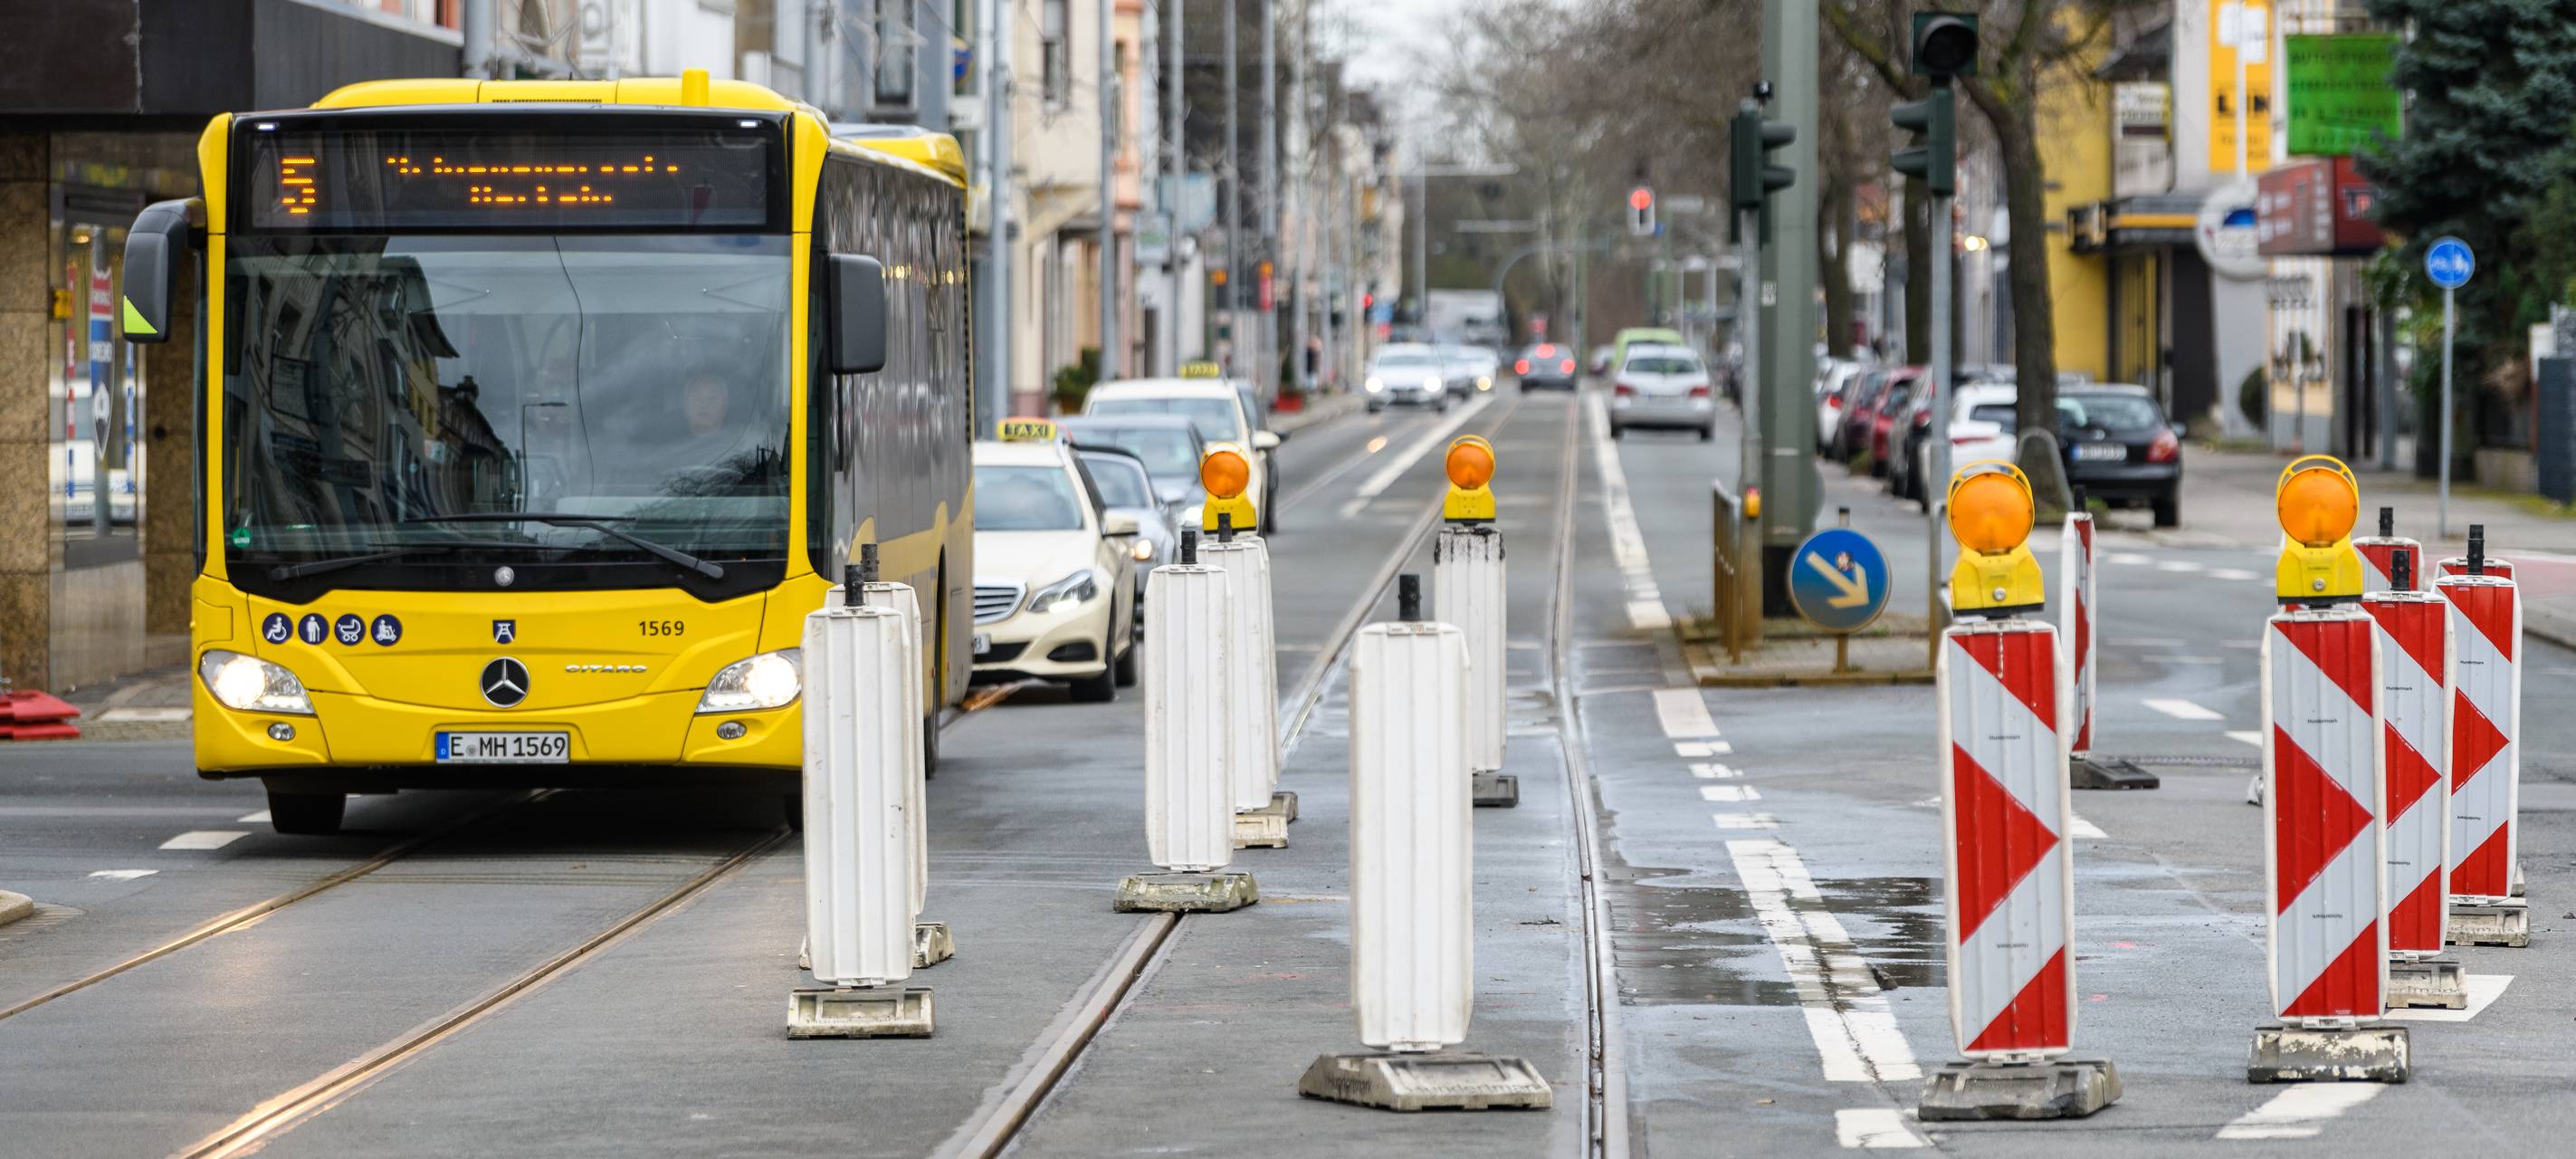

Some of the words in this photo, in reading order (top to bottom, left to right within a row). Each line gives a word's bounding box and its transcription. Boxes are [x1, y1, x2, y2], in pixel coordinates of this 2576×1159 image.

[282, 158, 316, 214] 5
[1005, 422, 1047, 436] TAXI
[639, 620, 685, 637] 1569
[451, 736, 463, 756] E
[480, 736, 507, 757] MH
[513, 736, 567, 757] 1569
